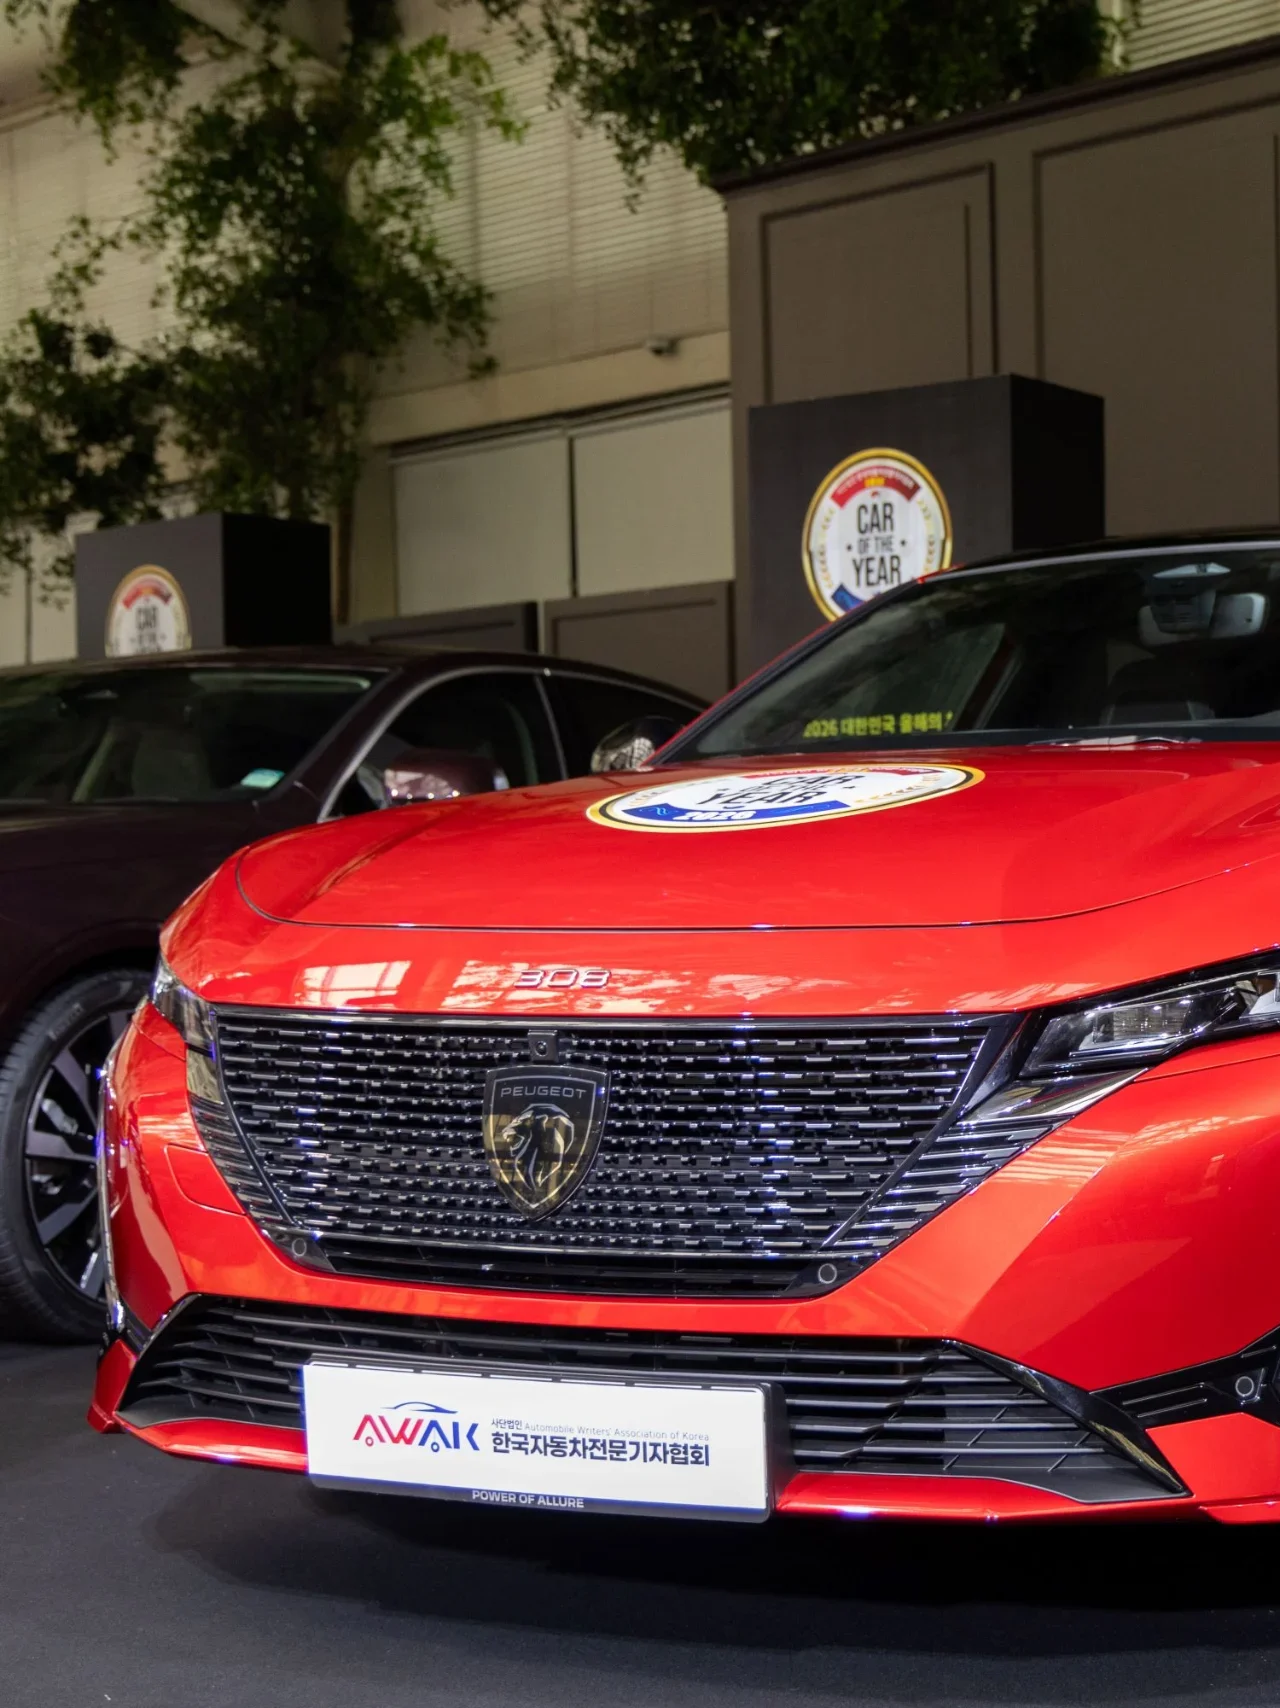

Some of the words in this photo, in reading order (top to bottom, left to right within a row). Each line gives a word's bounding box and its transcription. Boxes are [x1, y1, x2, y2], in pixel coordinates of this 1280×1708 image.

[857, 502, 894, 534] CAR
[857, 537, 871, 554] OF
[874, 535, 894, 553] THE
[852, 555, 902, 588] YEAR
[514, 968, 612, 989] 308
[500, 1086, 587, 1099] PEUGEOT
[352, 1413, 480, 1453] AWAK
[491, 1418, 523, 1431] 사단법인
[525, 1422, 575, 1434] Automobile
[614, 1428, 668, 1439] Association
[670, 1430, 680, 1440] of
[682, 1431, 710, 1442] Korea
[491, 1431, 710, 1467] 한국자동차전문기자협회
[472, 1489, 516, 1503] POWER
[518, 1493, 535, 1505] OF
[537, 1496, 585, 1508] ALLURE
